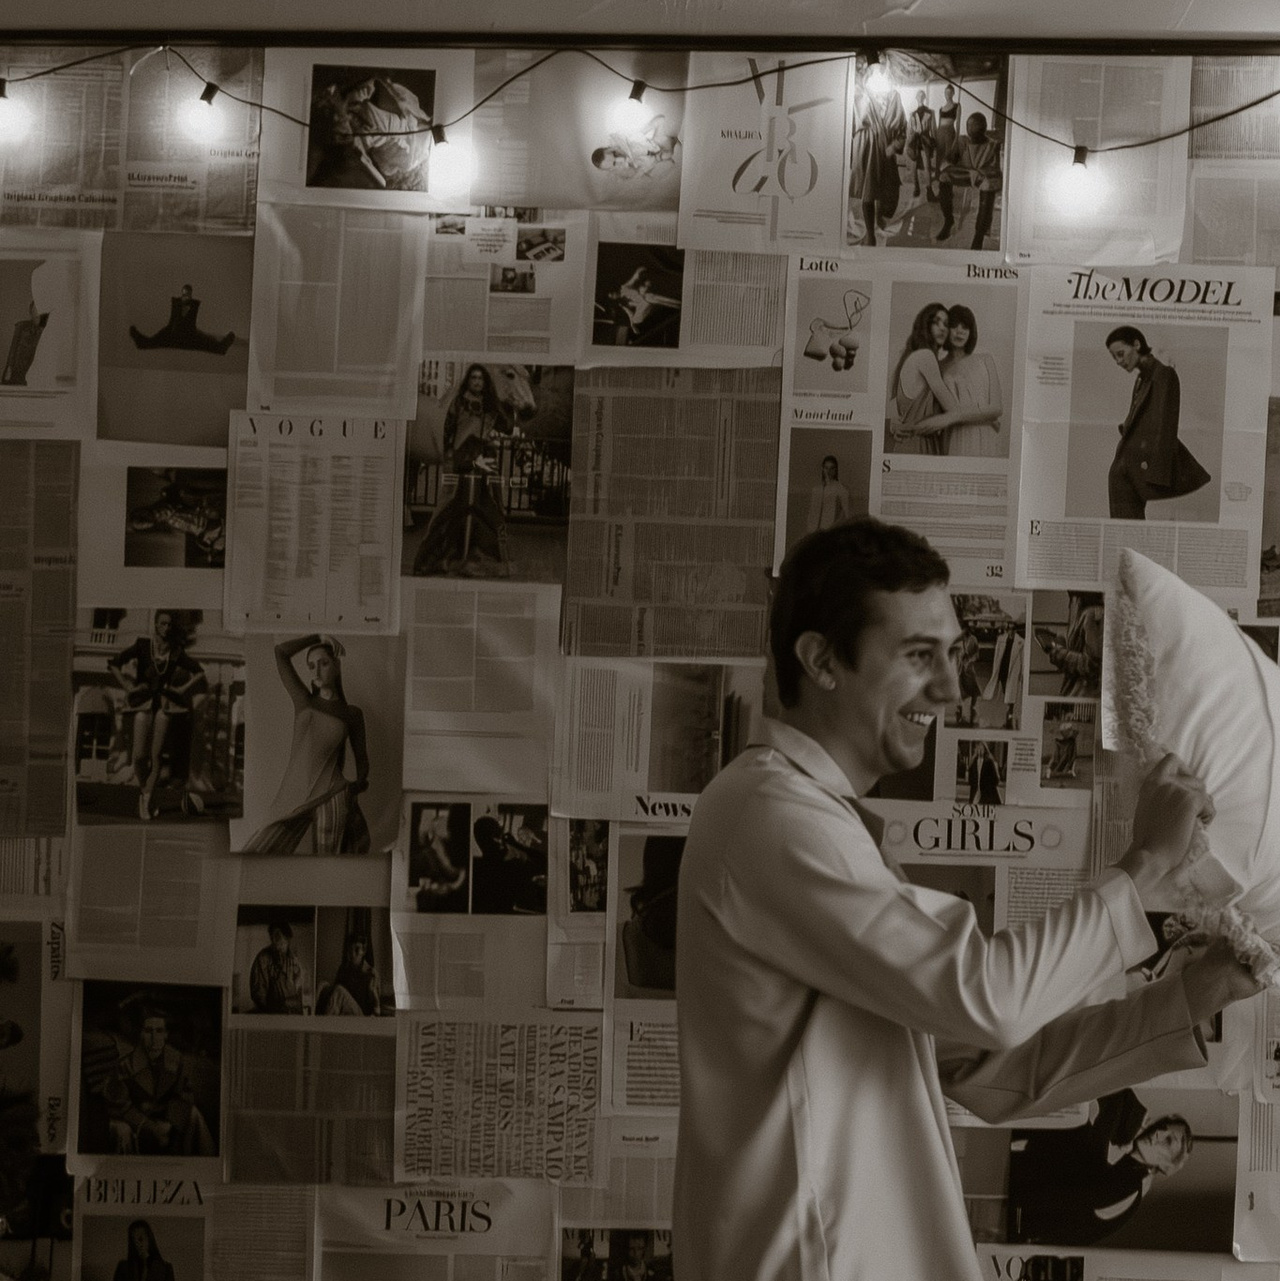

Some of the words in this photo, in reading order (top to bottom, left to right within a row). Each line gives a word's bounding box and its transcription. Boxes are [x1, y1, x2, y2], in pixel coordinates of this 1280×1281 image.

[799, 257, 839, 273] Lotte
[966, 263, 1019, 280] Barnes
[1117, 276, 1243, 307] MODEL
[248, 417, 386, 440] VOGUE
[1030, 520, 1041, 536] E
[634, 795, 692, 817] News
[912, 817, 1035, 852] GIRLS
[419, 1022, 436, 1102] MARGOT
[500, 1023, 517, 1074] KATE
[549, 1024, 567, 1079] SARA
[582, 1026, 598, 1113] MADISON
[499, 1079, 516, 1131] MOSS
[546, 1081, 566, 1180] SAMPAIO
[85, 1178, 205, 1206] BELLEZA
[383, 1197, 494, 1234] PARIS
